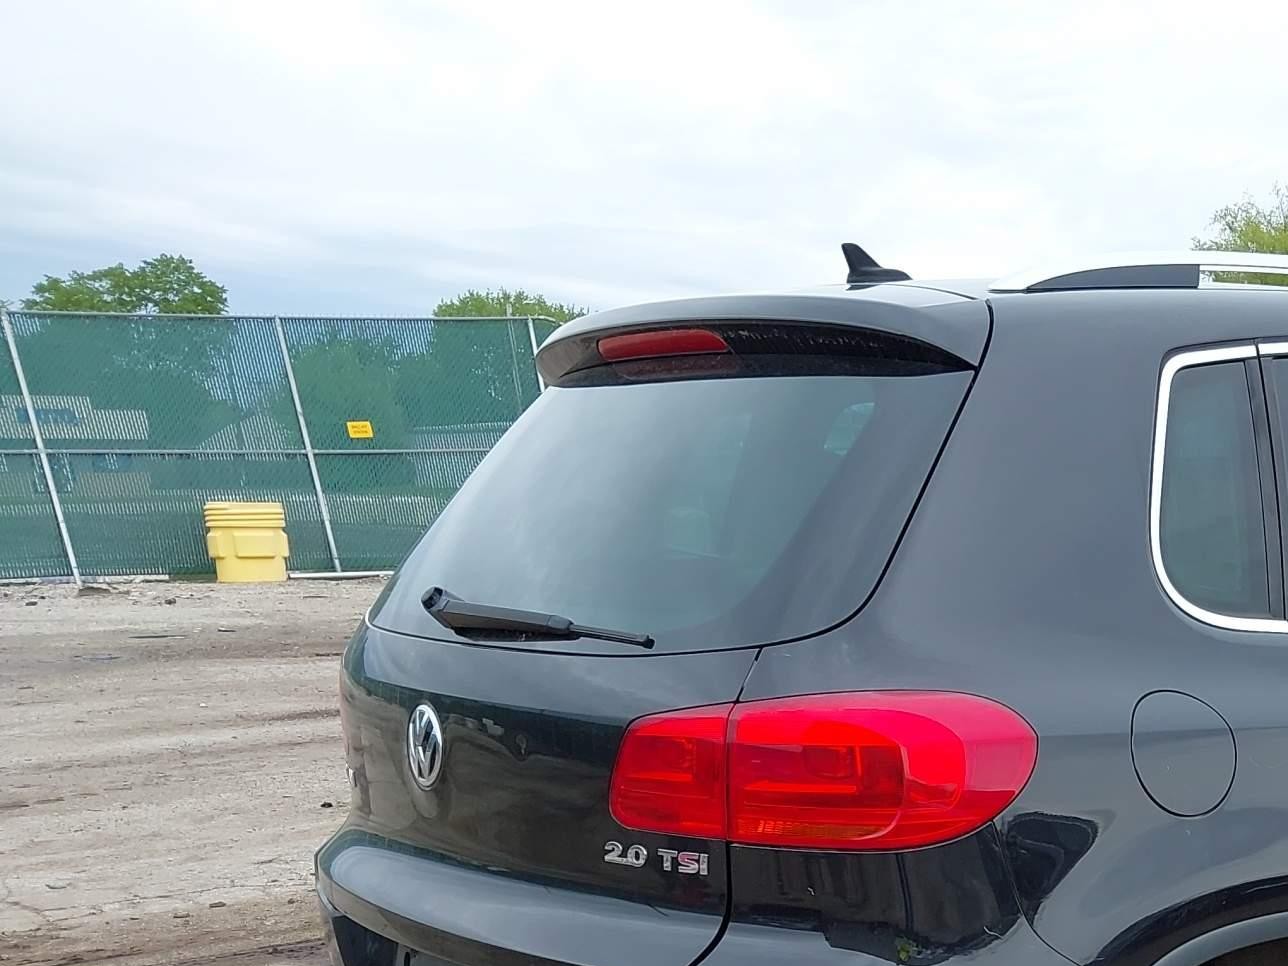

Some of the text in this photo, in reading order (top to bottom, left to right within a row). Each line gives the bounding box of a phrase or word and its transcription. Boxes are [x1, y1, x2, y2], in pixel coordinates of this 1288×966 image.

[408, 704, 443, 788] VW
[604, 841, 709, 875] 2.0 TSI
